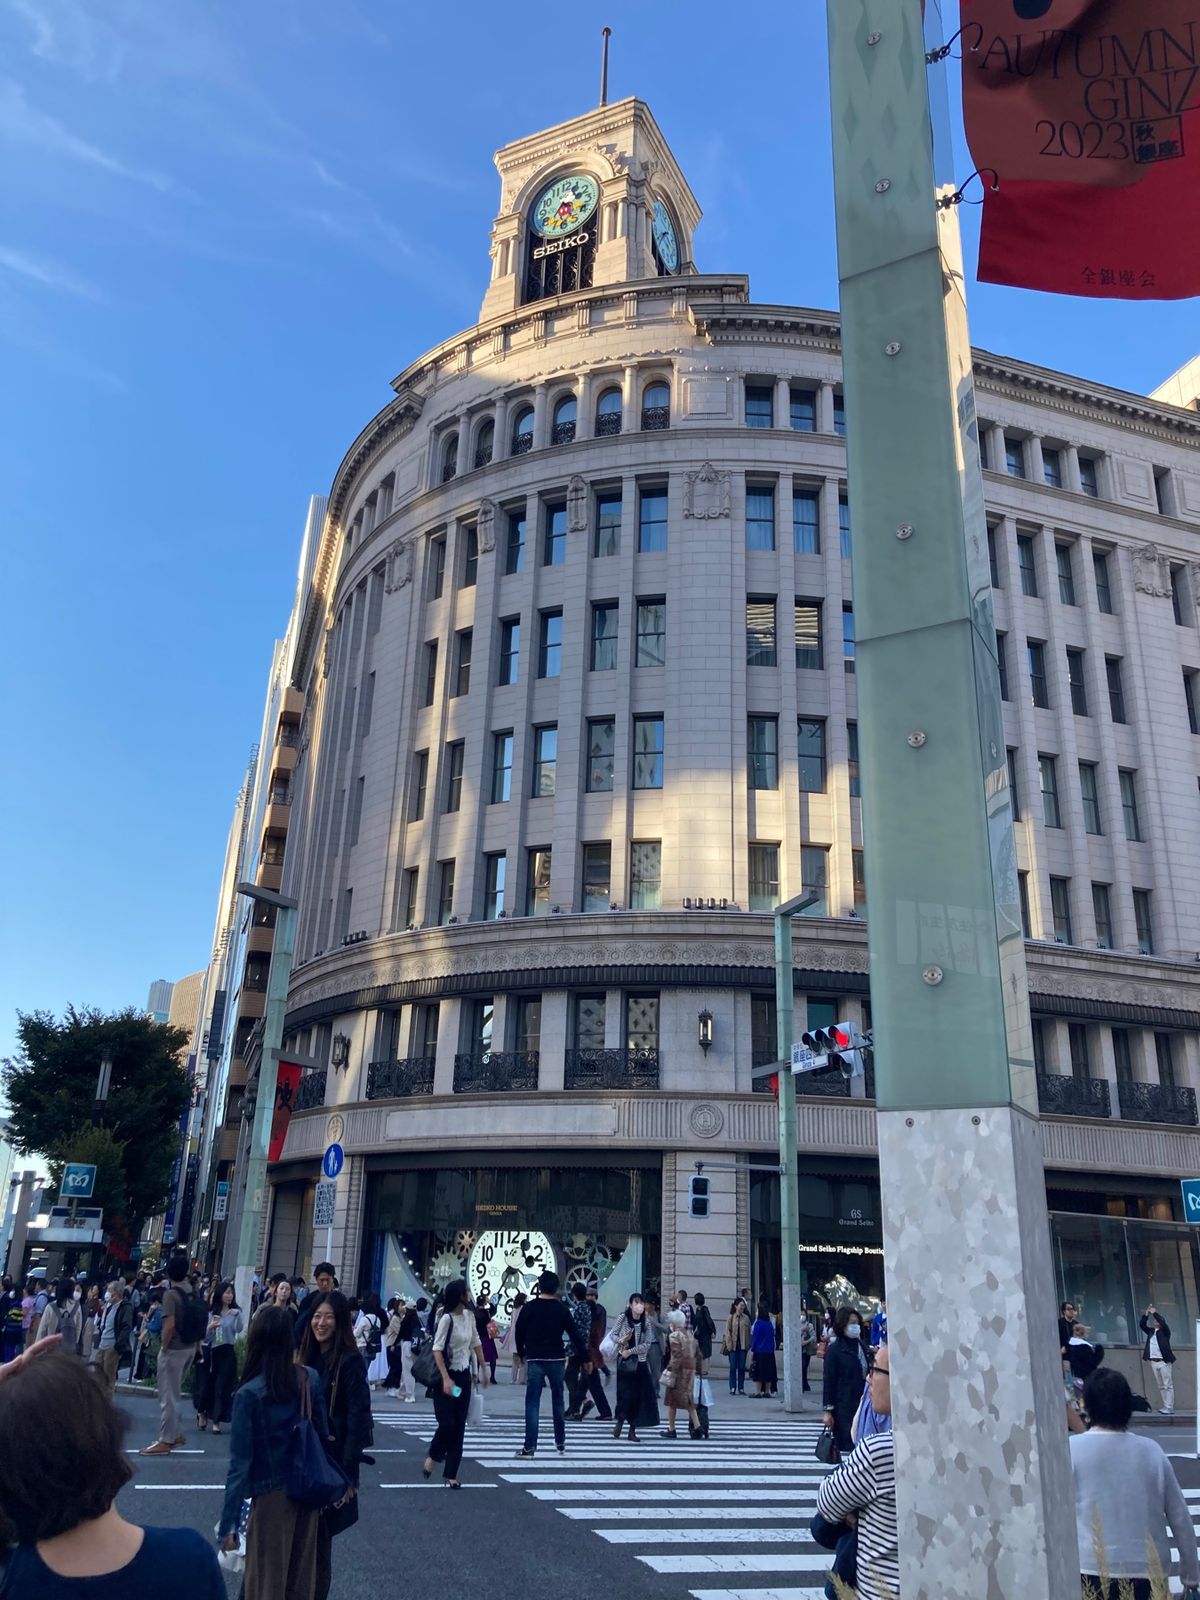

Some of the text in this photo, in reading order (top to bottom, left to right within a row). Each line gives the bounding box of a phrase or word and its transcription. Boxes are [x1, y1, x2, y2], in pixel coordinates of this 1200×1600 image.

[977, 21, 1198, 79] AUTUMN
[1084, 65, 1200, 122] GINZ
[1035, 120, 1130, 160] 2023
[533, 233, 589, 260] SEIKO
[850, 1209, 862, 1219] GS
[494, 1231, 503, 1248] 11
[482, 1245, 493, 1262] 10
[534, 1245, 543, 1262] 2
[818, 1245, 836, 1253] Seiko
[837, 1246, 863, 1255] Flagship
[864, 1247, 885, 1256] Boutiq
[476, 1263, 486, 1279] 9
[480, 1280, 491, 1296] 8
